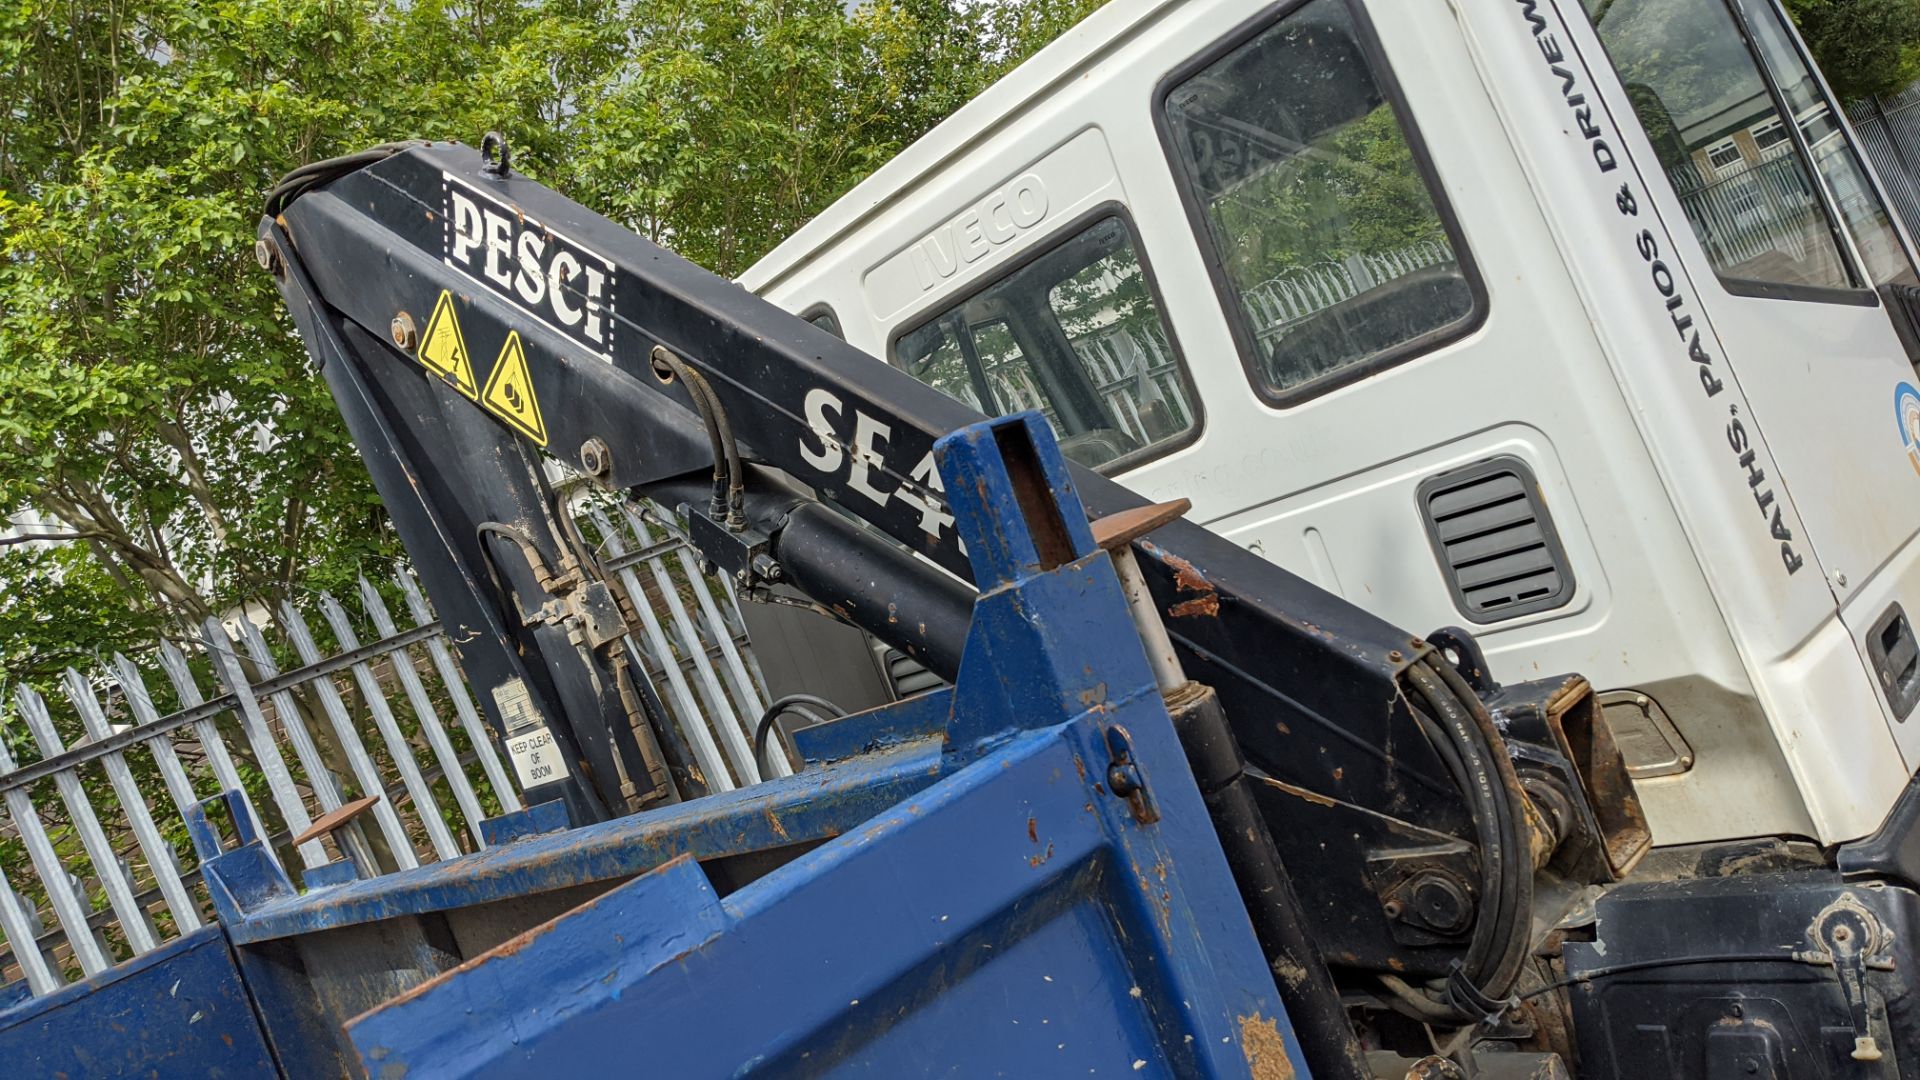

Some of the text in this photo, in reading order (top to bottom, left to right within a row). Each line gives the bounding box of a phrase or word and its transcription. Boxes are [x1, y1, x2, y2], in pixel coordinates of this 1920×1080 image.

[1616, 182, 1638, 216] &
[909, 173, 1049, 291] IVECO
[451, 190, 605, 344] PESCI
[1636, 229, 1724, 398] PATIOS
[510, 733, 553, 755] KEEP CLEAR
[530, 752, 541, 764] OF
[530, 765, 552, 780] BOOM
